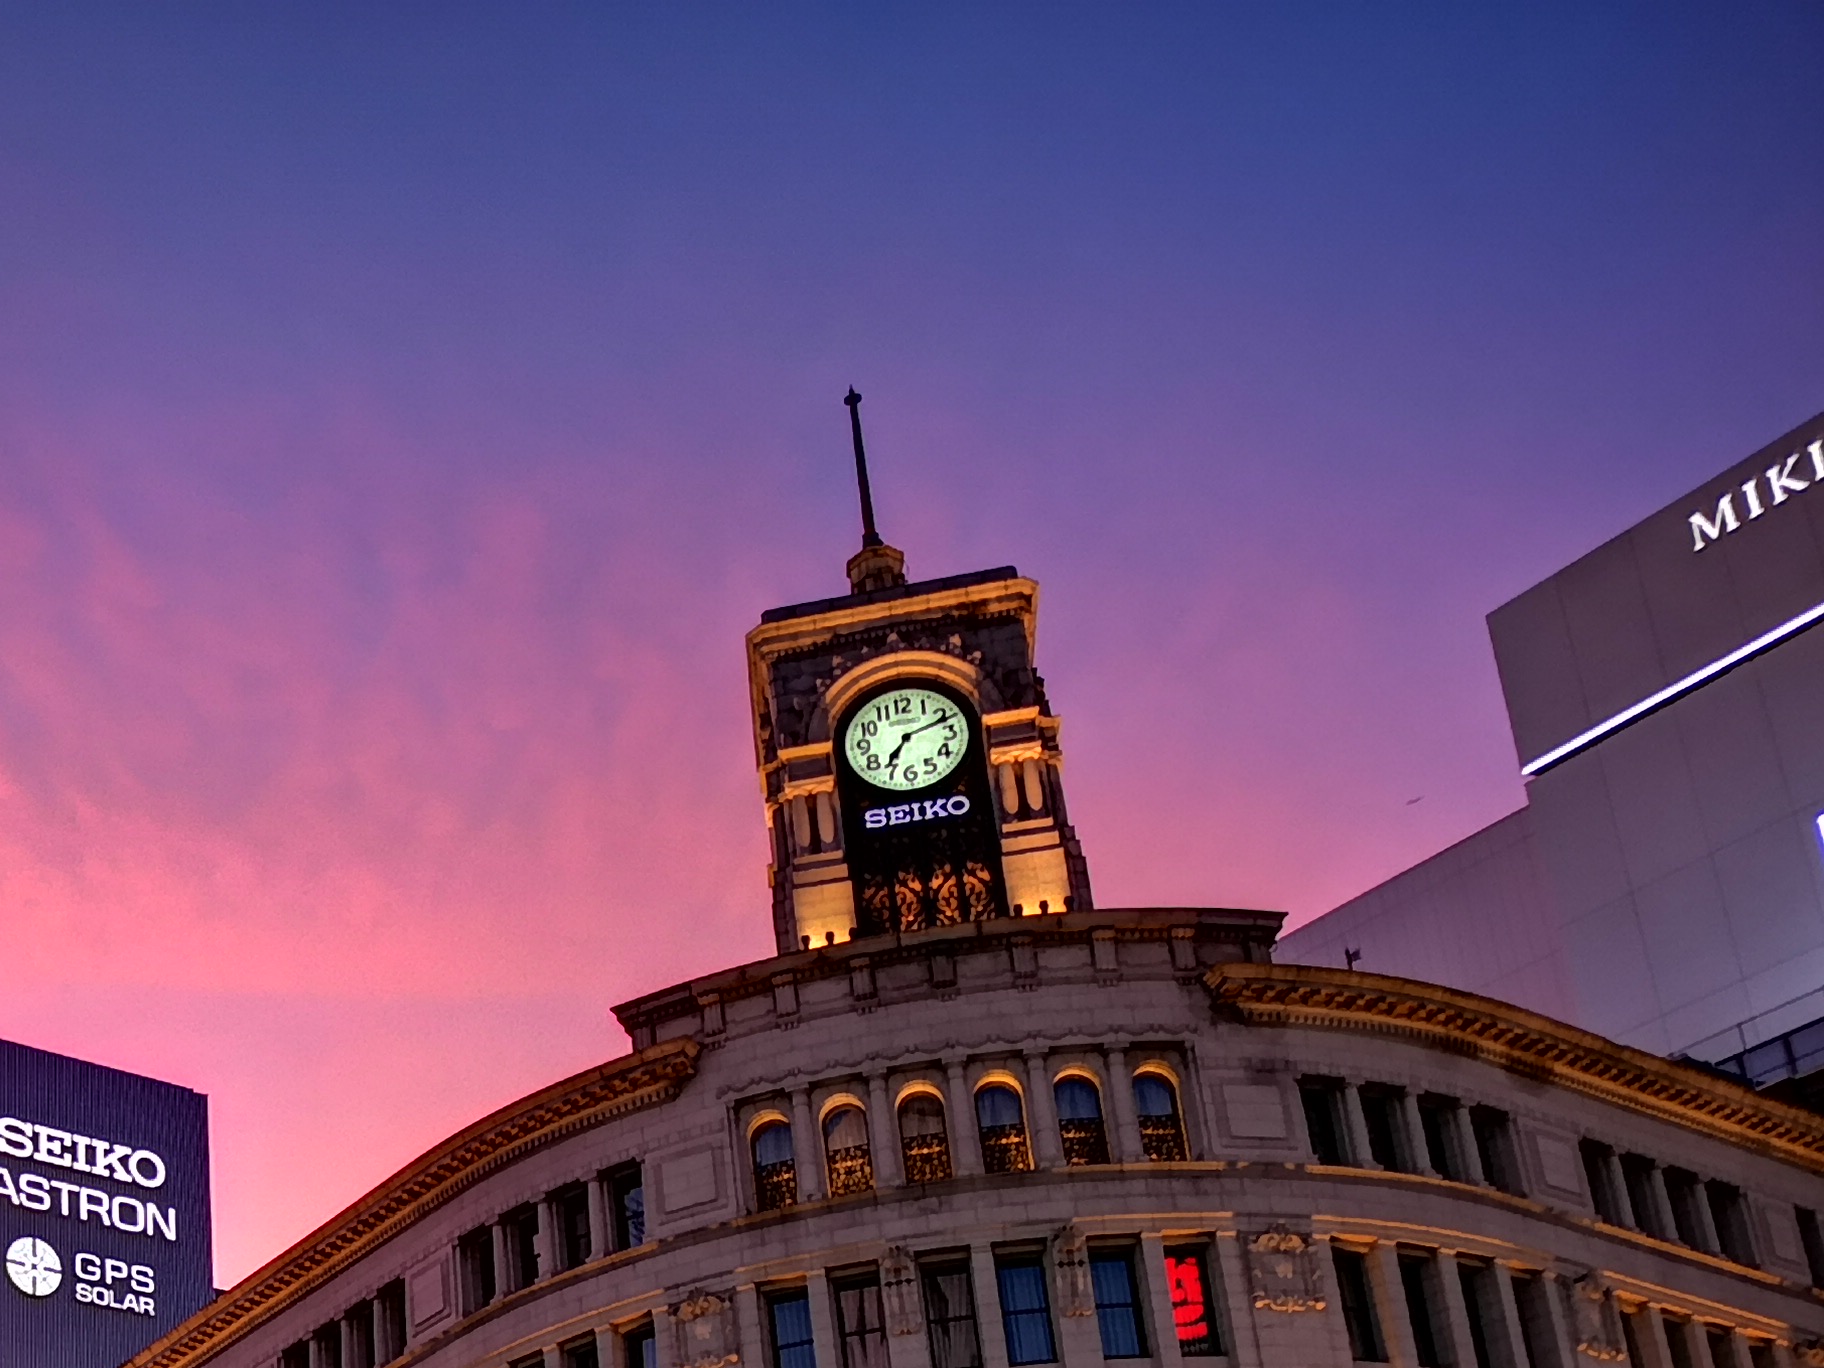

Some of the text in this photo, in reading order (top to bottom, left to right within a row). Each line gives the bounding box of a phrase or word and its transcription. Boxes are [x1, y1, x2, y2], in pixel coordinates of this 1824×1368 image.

[1688, 440, 1824, 552] MIKI
[877, 705, 890, 722] 11
[893, 697, 912, 716] 12
[921, 698, 927, 715] 1
[860, 720, 878, 738] 10
[942, 724, 958, 741] 3
[856, 738, 871, 756] 9
[937, 742, 954, 759] 4
[866, 754, 881, 771] 8
[923, 757, 938, 775] 5
[903, 764, 919, 782] 6
[864, 795, 970, 829] SEIKO
[75, 1253, 156, 1294] GPS
[76, 1283, 156, 1316] SOLAR
